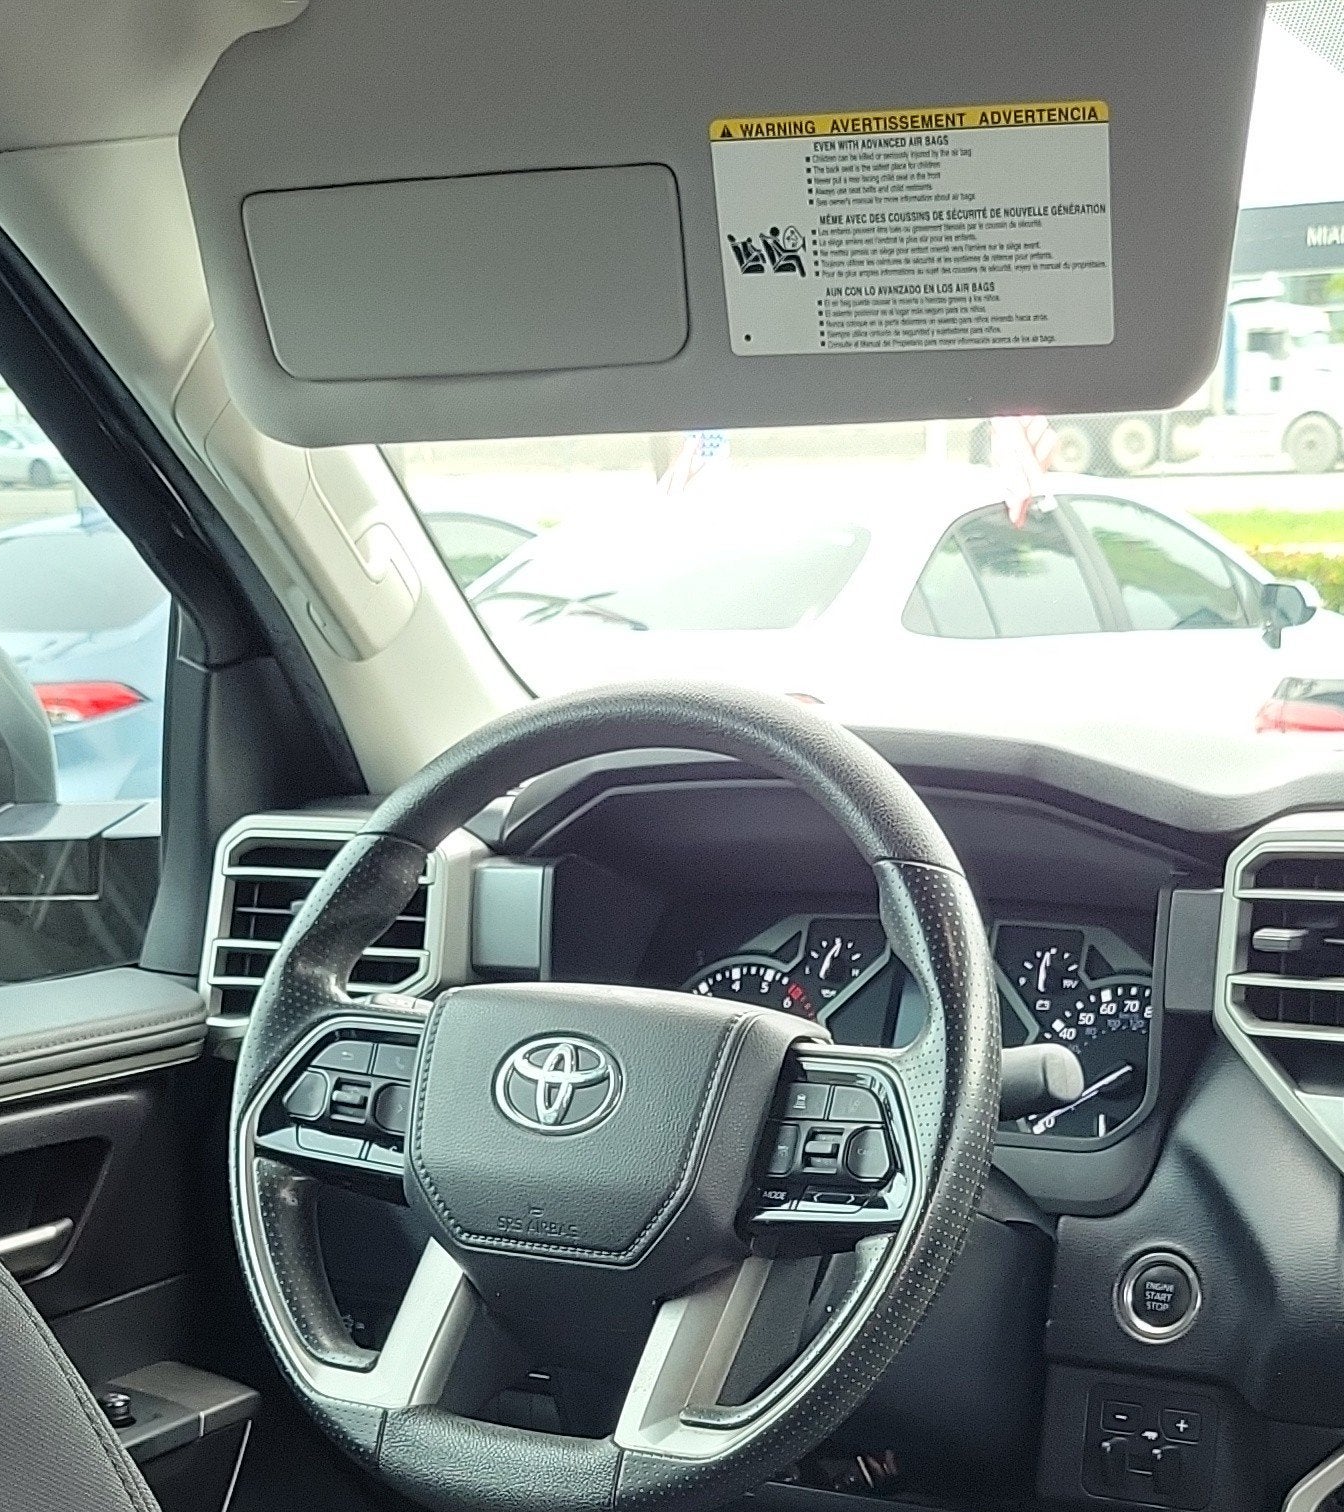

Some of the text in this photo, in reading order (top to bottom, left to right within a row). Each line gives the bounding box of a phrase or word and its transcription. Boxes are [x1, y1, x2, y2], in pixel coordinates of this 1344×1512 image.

[740, 106, 1099, 138] WARNING AVERTISSEMENT ADVERTENCIA
[813, 135, 949, 152] EVEN WITH ADVANCED AIR BAGS
[845, 213, 867, 224] AVEC
[869, 213, 886, 223] DES
[888, 211, 930, 222] COUSSINS
[932, 210, 944, 220] DE
[946, 207, 987, 220] SÉCURITÉ
[989, 208, 1001, 218] DE
[1003, 206, 1049, 217] NOUVELLE
[1051, 203, 1106, 216] GÉNÉRATION
[844, 286, 862, 296] CON
[864, 285, 876, 295] LO
[878, 284, 921, 295] AVANZADO
[923, 284, 935, 294] EN
[936, 283, 953, 293] LOS
[955, 283, 969, 292] AIR
[971, 281, 995, 292] BAGS
[731, 980, 741, 992] 4
[759, 981, 770, 994] 5
[782, 997, 792, 1008] 6
[1099, 1002, 1117, 1015] 60
[1123, 999, 1140, 1013] 70
[1077, 1012, 1095, 1025] 50
[1058, 1027, 1077, 1040] 40
[762, 1190, 787, 1200] MODE
[1146, 1281, 1174, 1292] ENGINE
[1145, 1291, 1173, 1302] START
[1146, 1301, 1169, 1311] STOP
